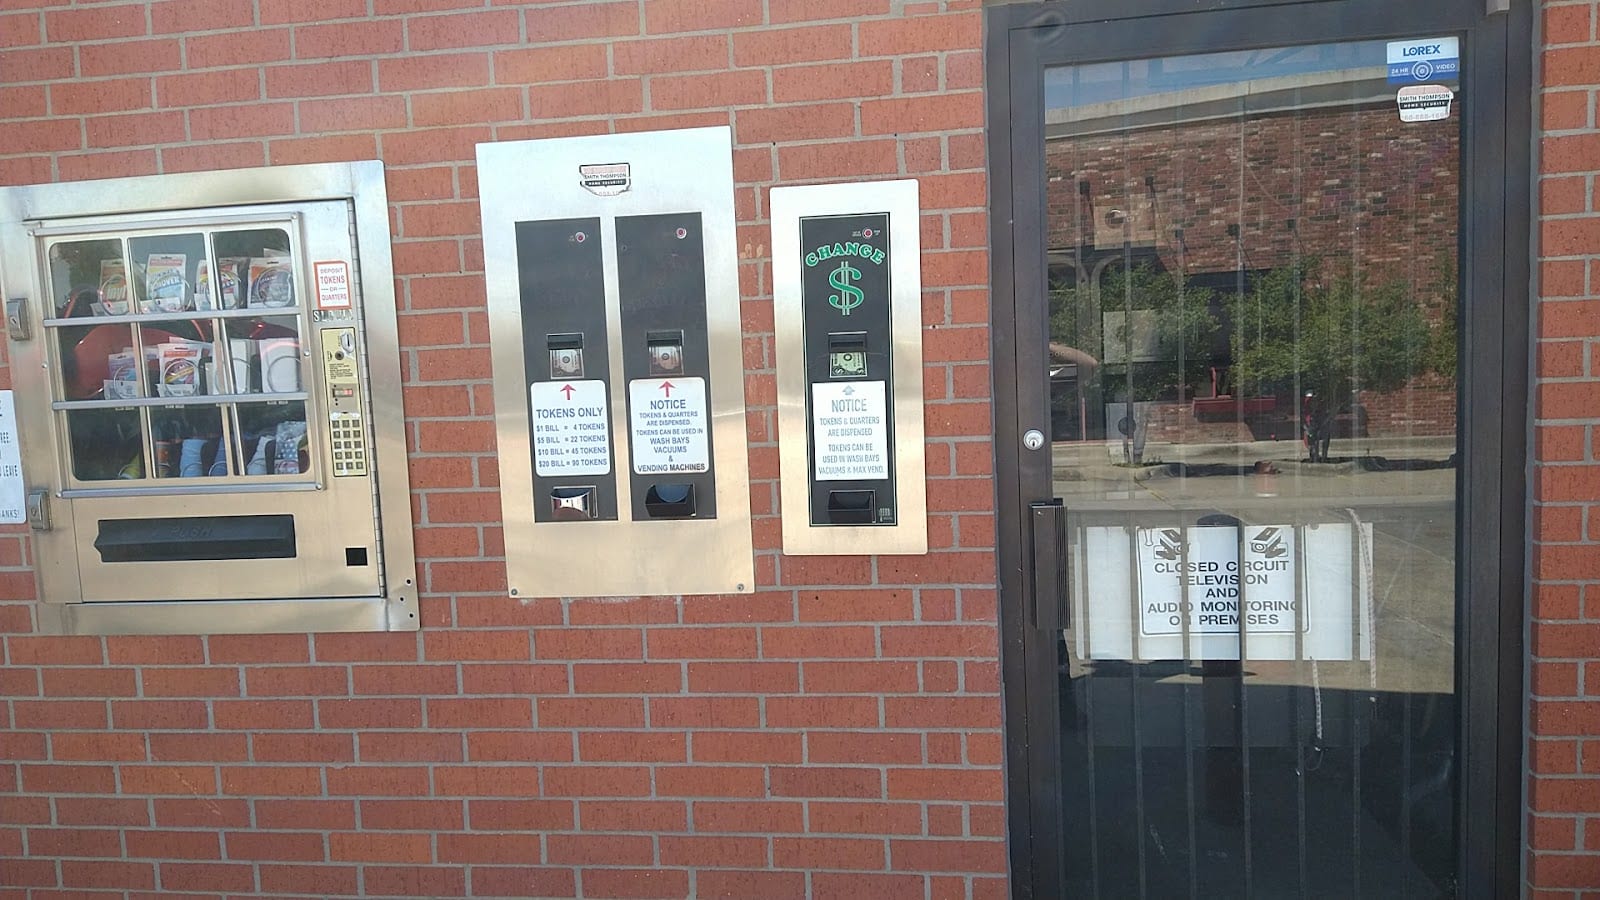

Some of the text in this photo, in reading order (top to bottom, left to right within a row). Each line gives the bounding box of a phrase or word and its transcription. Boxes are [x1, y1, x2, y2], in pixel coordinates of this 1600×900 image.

[1403, 45, 1440, 56] LOREX
[805, 242, 885, 267] CHANGE
[320, 275, 345, 284] TOKENS
[321, 293, 347, 301] QUARTERS
[650, 399, 686, 410] NOTICE
[831, 398, 867, 412] NOTICE
[536, 407, 603, 419] TOKENS ONLY
[639, 411, 662, 419] TOKENS
[819, 417, 842, 426] TOKENS
[849, 416, 880, 425] QUARTERS
[536, 424, 544, 432] $1
[545, 424, 560, 432] BILL
[578, 423, 605, 431] TOKENS
[827, 427, 873, 437] ARE DISPENSED
[537, 436, 545, 444] $5
[546, 436, 560, 444] BILL
[570, 435, 578, 443] 22
[579, 435, 606, 443] TOKENS
[649, 437, 671, 445] WASH
[538, 448, 549, 456] $10
[550, 448, 564, 456] BILL
[571, 447, 579, 455] 45
[580, 446, 607, 455] TOKENS
[828, 442, 873, 452] TOKENS CAN BE
[538, 460, 550, 468] $20
[572, 459, 579, 467] 90
[581, 458, 608, 467] TOKENS
[822, 454, 880, 463] USED IN WASH BAYS
[637, 463, 705, 472] VENDING MACHINES
[818, 466, 846, 475] VACUUMS
[846, 466, 852, 474] &
[852, 466, 867, 474] MAX
[1154, 560, 1289, 573] CLOSED CRCUIT
[1176, 574, 1268, 586] TELEVISON
[1205, 588, 1238, 598] AND
[1201, 601, 1296, 612] MONTORIN
[1199, 614, 1279, 625] PREMSES
